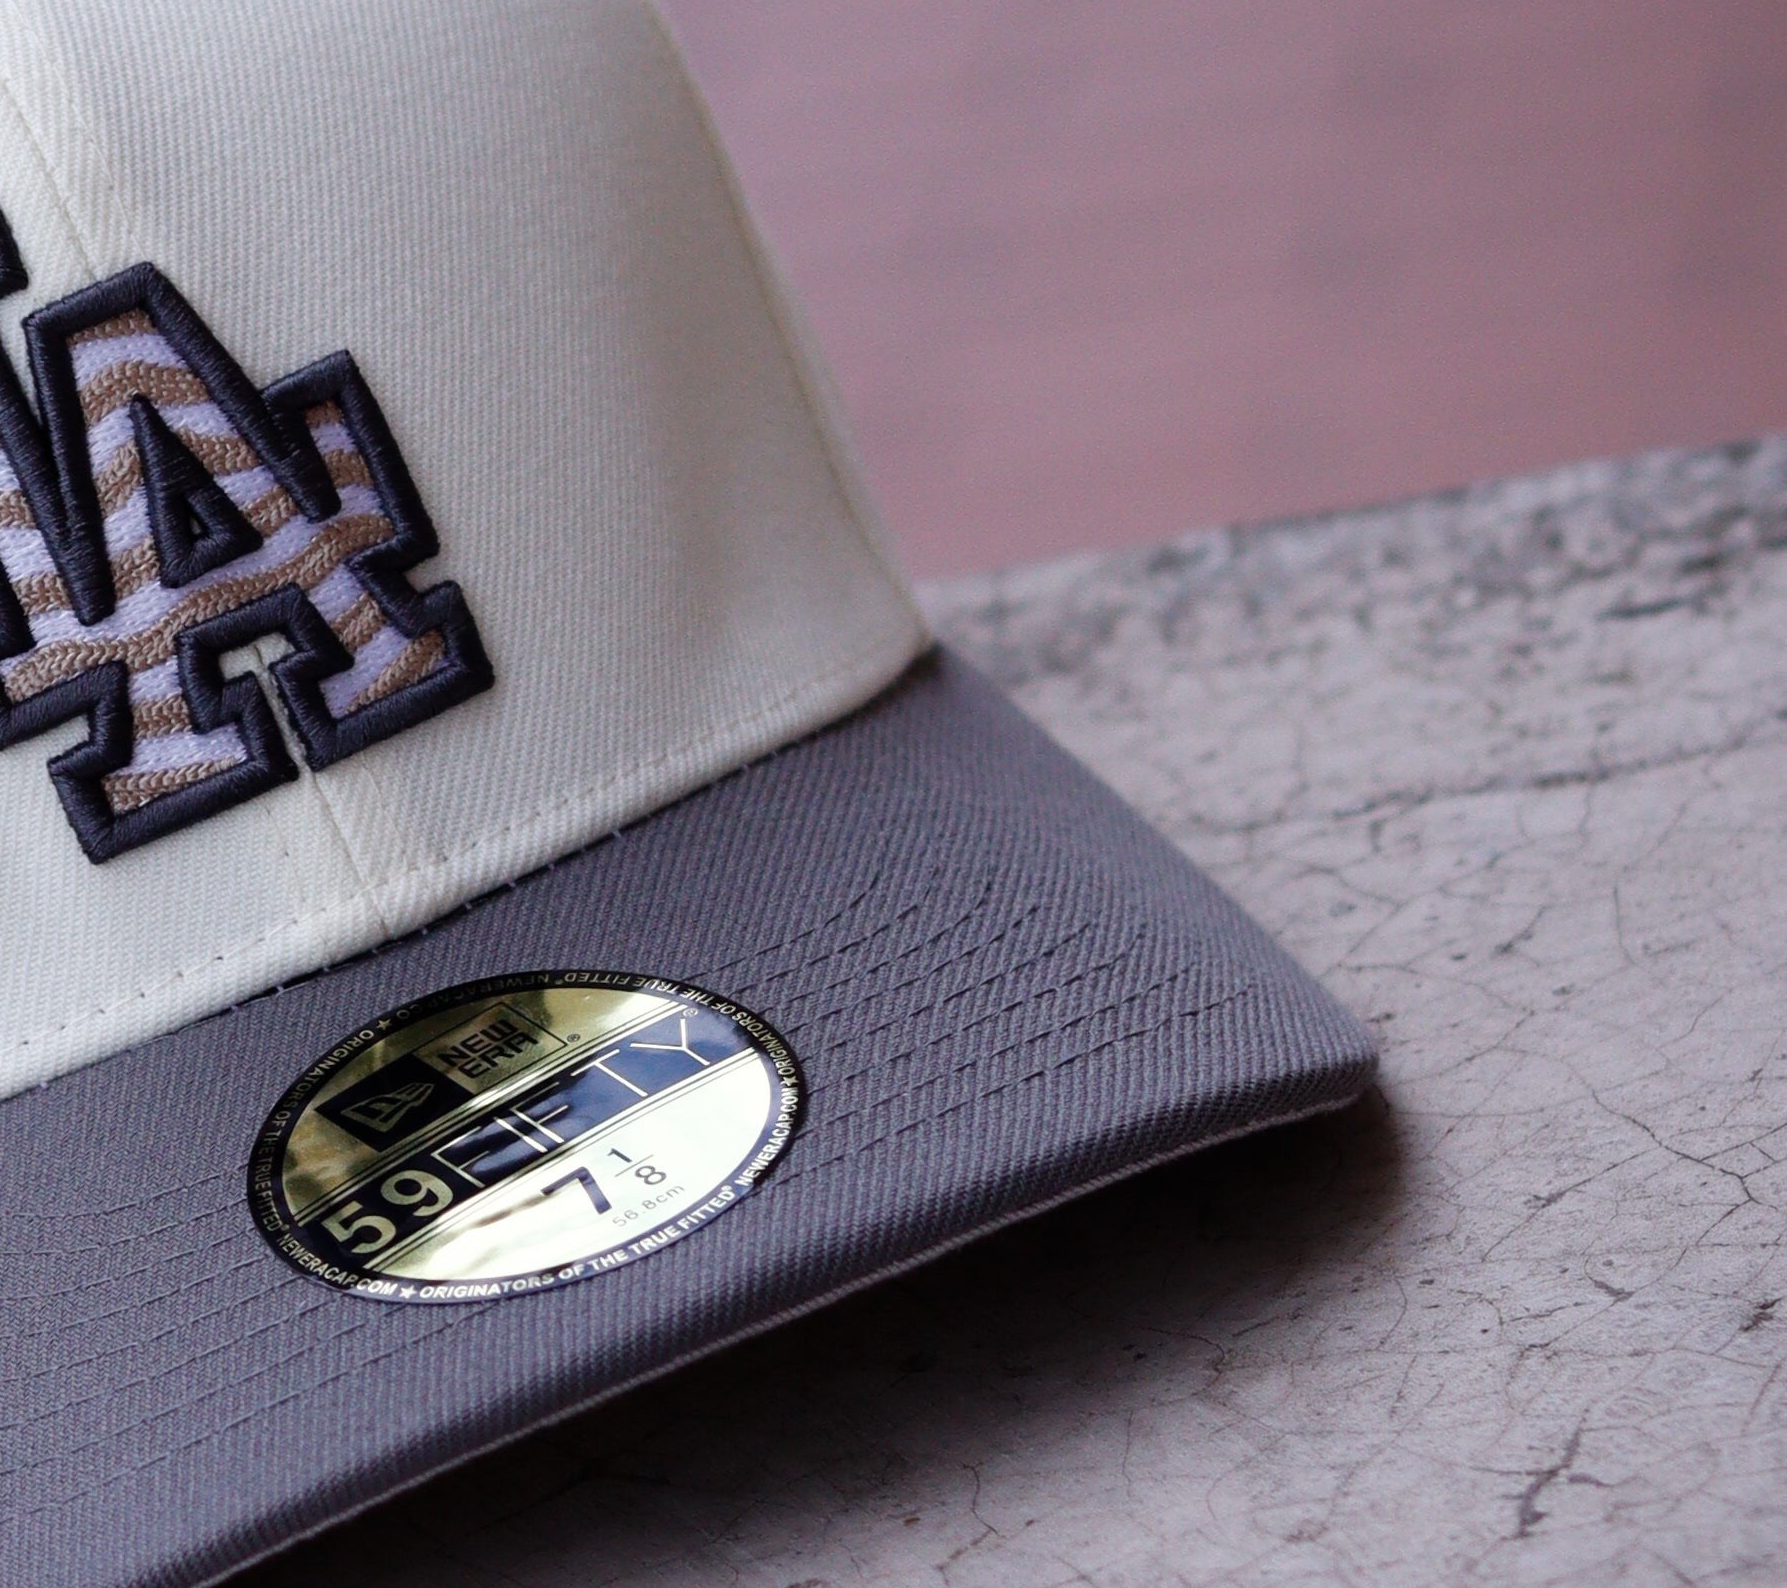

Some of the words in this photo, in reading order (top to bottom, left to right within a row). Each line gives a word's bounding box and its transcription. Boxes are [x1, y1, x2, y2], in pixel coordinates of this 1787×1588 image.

[632, 977, 680, 994] TRUE
[437, 1018, 520, 1068] NEW
[458, 1031, 539, 1079] ERA
[731, 1012, 796, 1078] ORIGINATORS
[282, 1029, 375, 1109] ORIGINATORS
[540, 1166, 612, 1215] 7
[612, 1184, 687, 1228] 56.8cm
[418, 1272, 556, 1300] ORIGINATORS
[558, 1263, 589, 1280] OF
[587, 1247, 629, 1271] THE
[628, 1224, 681, 1255] TRUE
